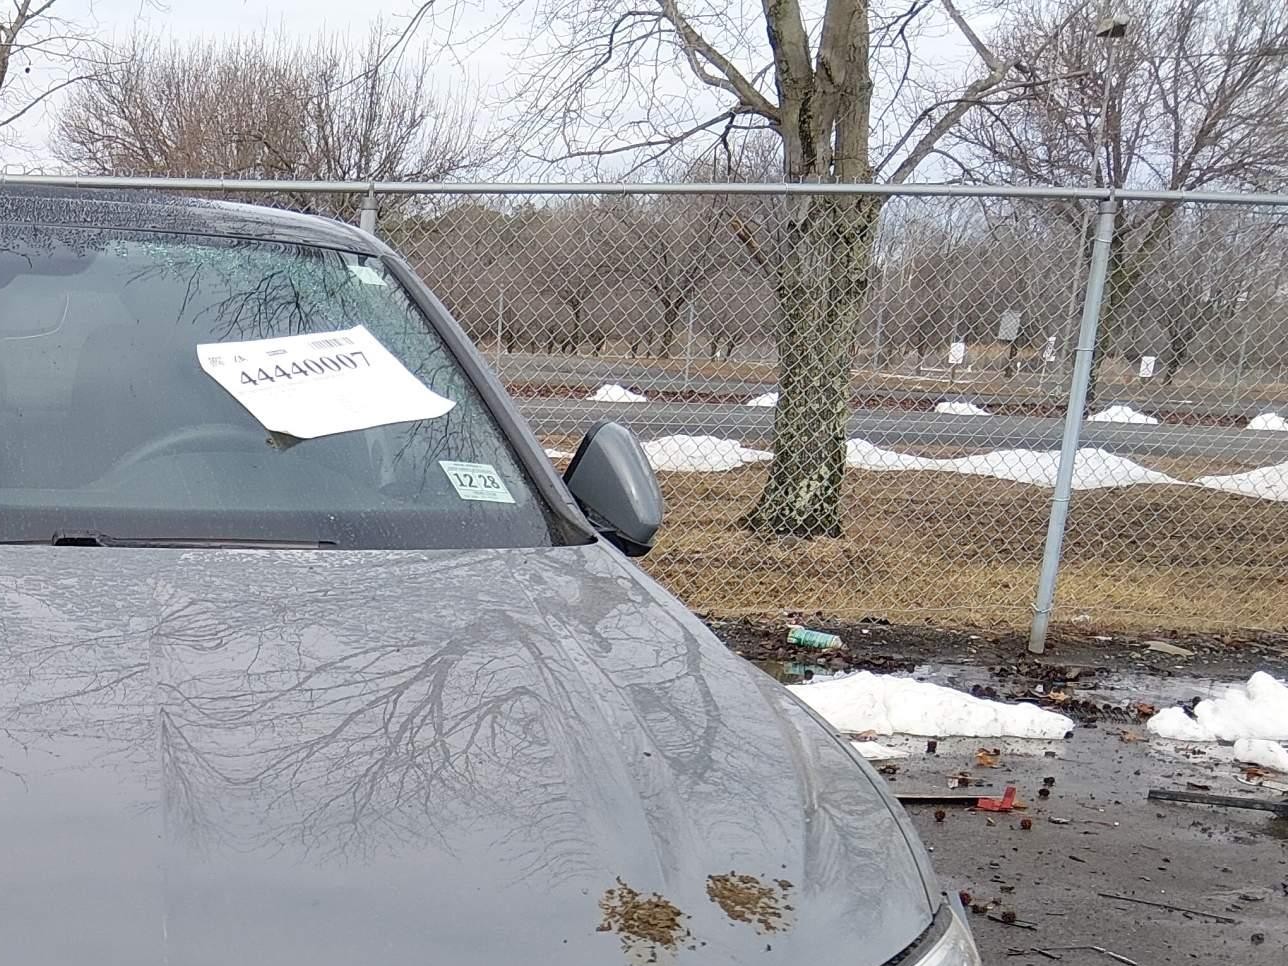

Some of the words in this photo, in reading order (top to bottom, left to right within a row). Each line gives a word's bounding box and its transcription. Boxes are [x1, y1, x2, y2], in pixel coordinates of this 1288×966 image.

[240, 351, 371, 386] 44440007
[453, 472, 477, 489] 12
[478, 473, 501, 490] 28
